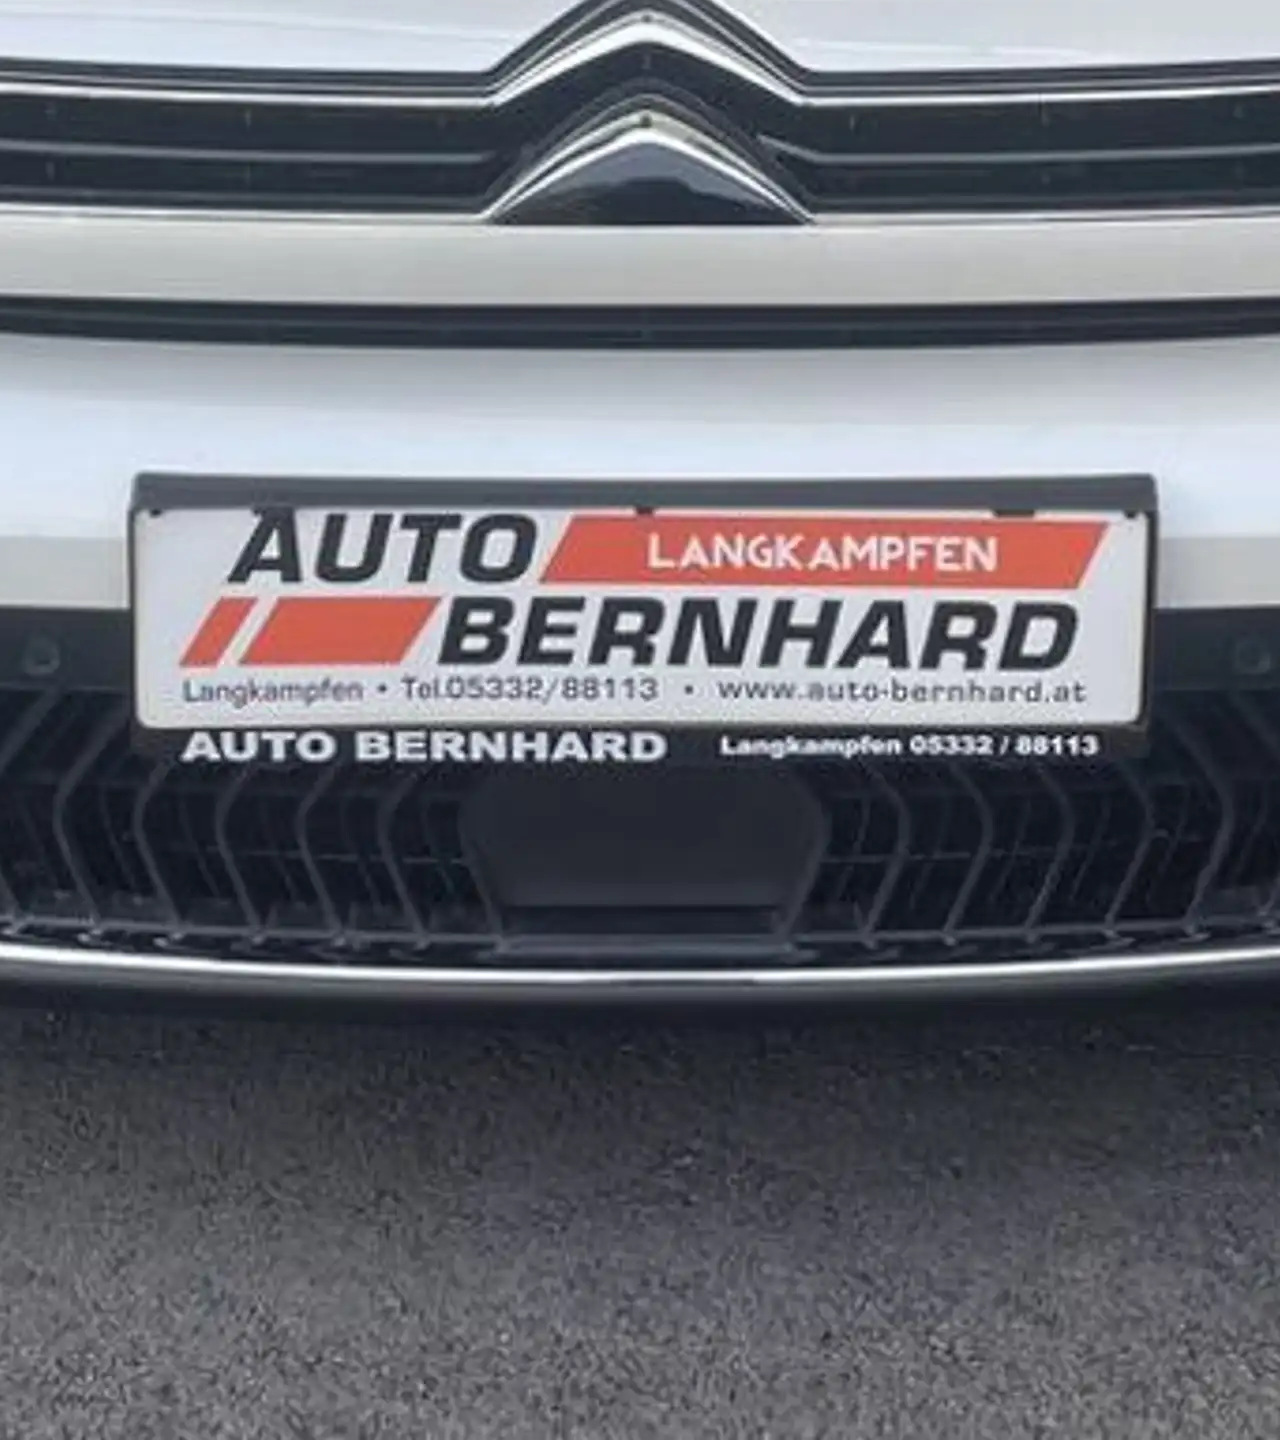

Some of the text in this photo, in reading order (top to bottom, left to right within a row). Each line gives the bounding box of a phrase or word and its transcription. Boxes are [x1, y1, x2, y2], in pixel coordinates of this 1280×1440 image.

[227, 511, 539, 585] AUTO
[647, 533, 1000, 573] LANGKAMPFEN
[438, 595, 1080, 672] BERNHARD
[183, 679, 365, 708] Langkampfen
[717, 680, 1087, 704] www.auto-bernhard.at
[182, 730, 337, 761] AUTO
[354, 730, 668, 762] BERNHARD
[720, 735, 903, 758] Langkampfen
[909, 734, 995, 755] 05332
[1015, 735, 1100, 756] 88113
